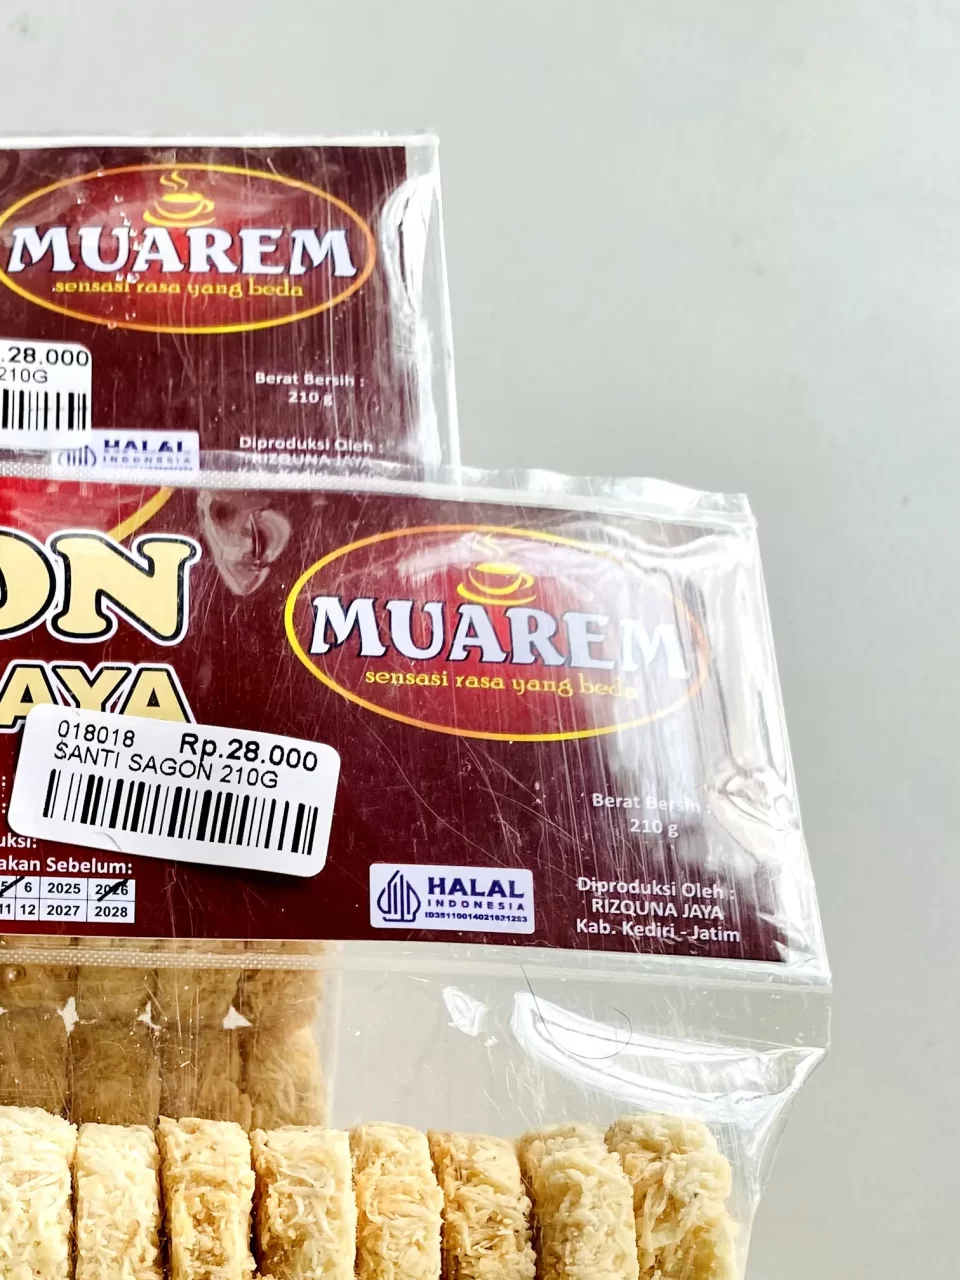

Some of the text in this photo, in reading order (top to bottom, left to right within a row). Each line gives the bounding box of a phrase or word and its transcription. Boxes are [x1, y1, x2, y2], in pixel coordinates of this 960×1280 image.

[7, 226, 358, 277] MUAREM
[55, 278, 303, 298] sensasi rasa yang beda
[255, 371, 299, 385] Berat
[304, 372, 355, 387] Bersih
[288, 391, 319, 404] 210
[240, 436, 329, 451] Diproduksi
[334, 438, 373, 452] Oleh
[310, 595, 692, 680] MUAREM
[365, 668, 638, 699] sensasi rasa yang beda
[57, 719, 318, 772] 018018 Rp.28.000
[53, 740, 279, 789] SANTI SAGON 210G
[592, 793, 640, 809] Berat
[630, 818, 679, 838] 210 g
[46, 856, 134, 875] Sebelum:
[24, 882, 33, 894] 6
[47, 883, 82, 895] 2025
[427, 877, 525, 898] HALAL
[577, 876, 676, 896] Diproduksi
[682, 882, 725, 899] Oleh
[20, 904, 36, 916] 12
[46, 904, 81, 917] 2027
[94, 906, 128, 918] 2028
[427, 899, 525, 911] INDONESIA
[592, 898, 725, 920] RIZQUNA JAYA
[576, 918, 616, 935] Kab.
[622, 921, 675, 939] Kediri
[690, 924, 741, 942] Jatim
